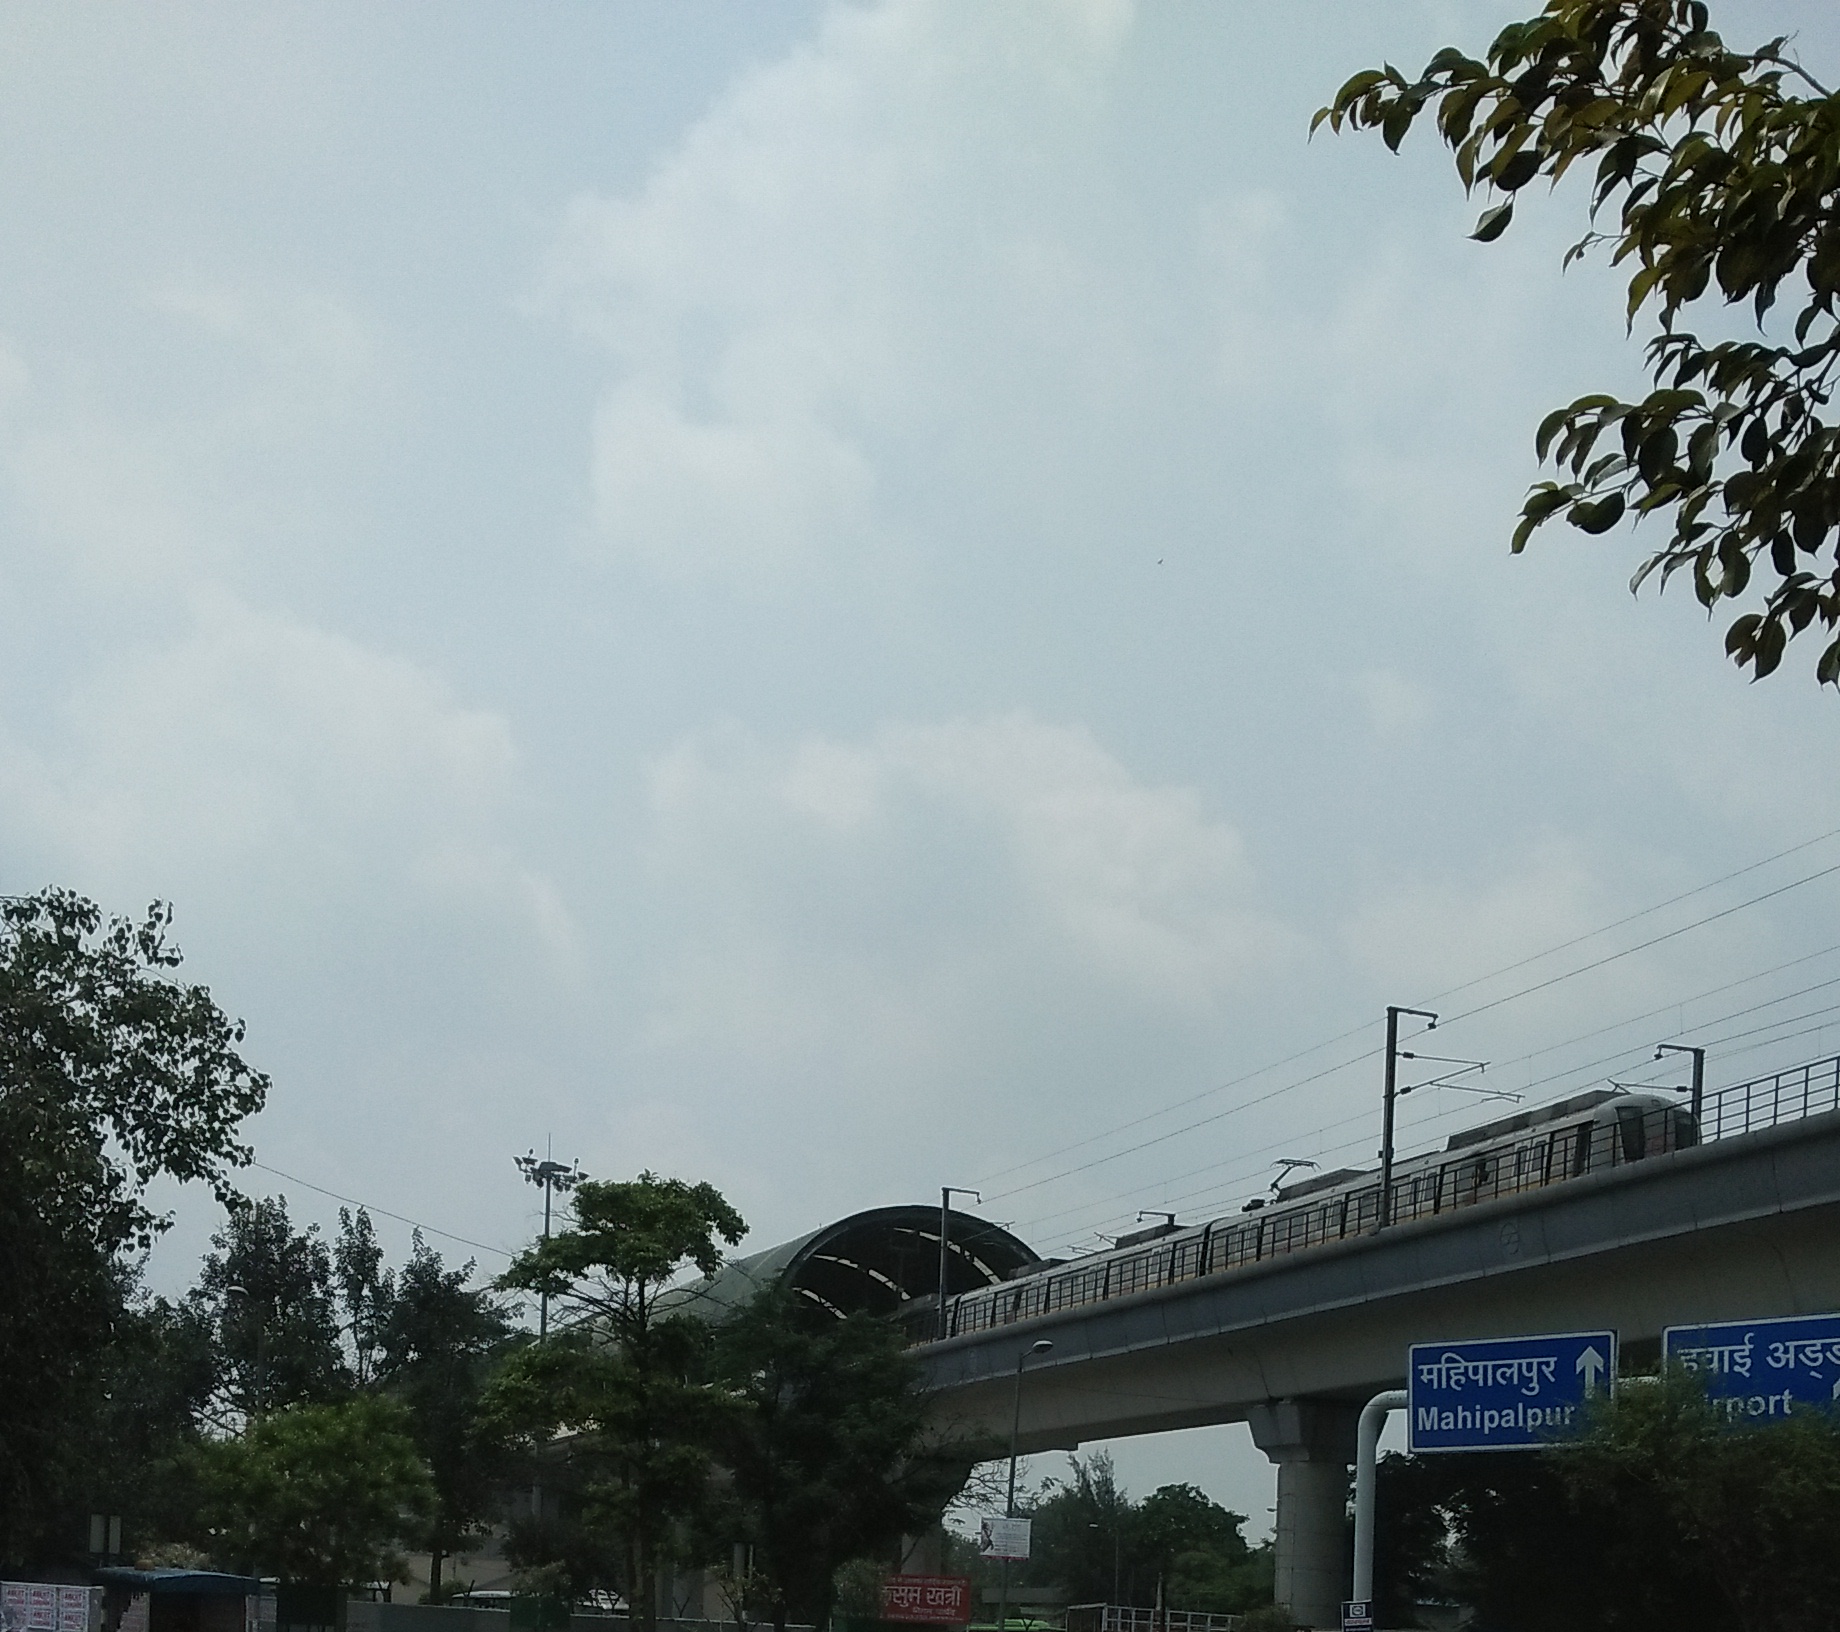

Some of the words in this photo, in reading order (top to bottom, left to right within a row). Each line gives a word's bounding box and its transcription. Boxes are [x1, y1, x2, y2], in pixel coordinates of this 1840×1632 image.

[1417, 1351, 1558, 1397] महिपालपुर
[1417, 1402, 1576, 1435] Mahipalpur
[1700, 1388, 1793, 1423] rport
